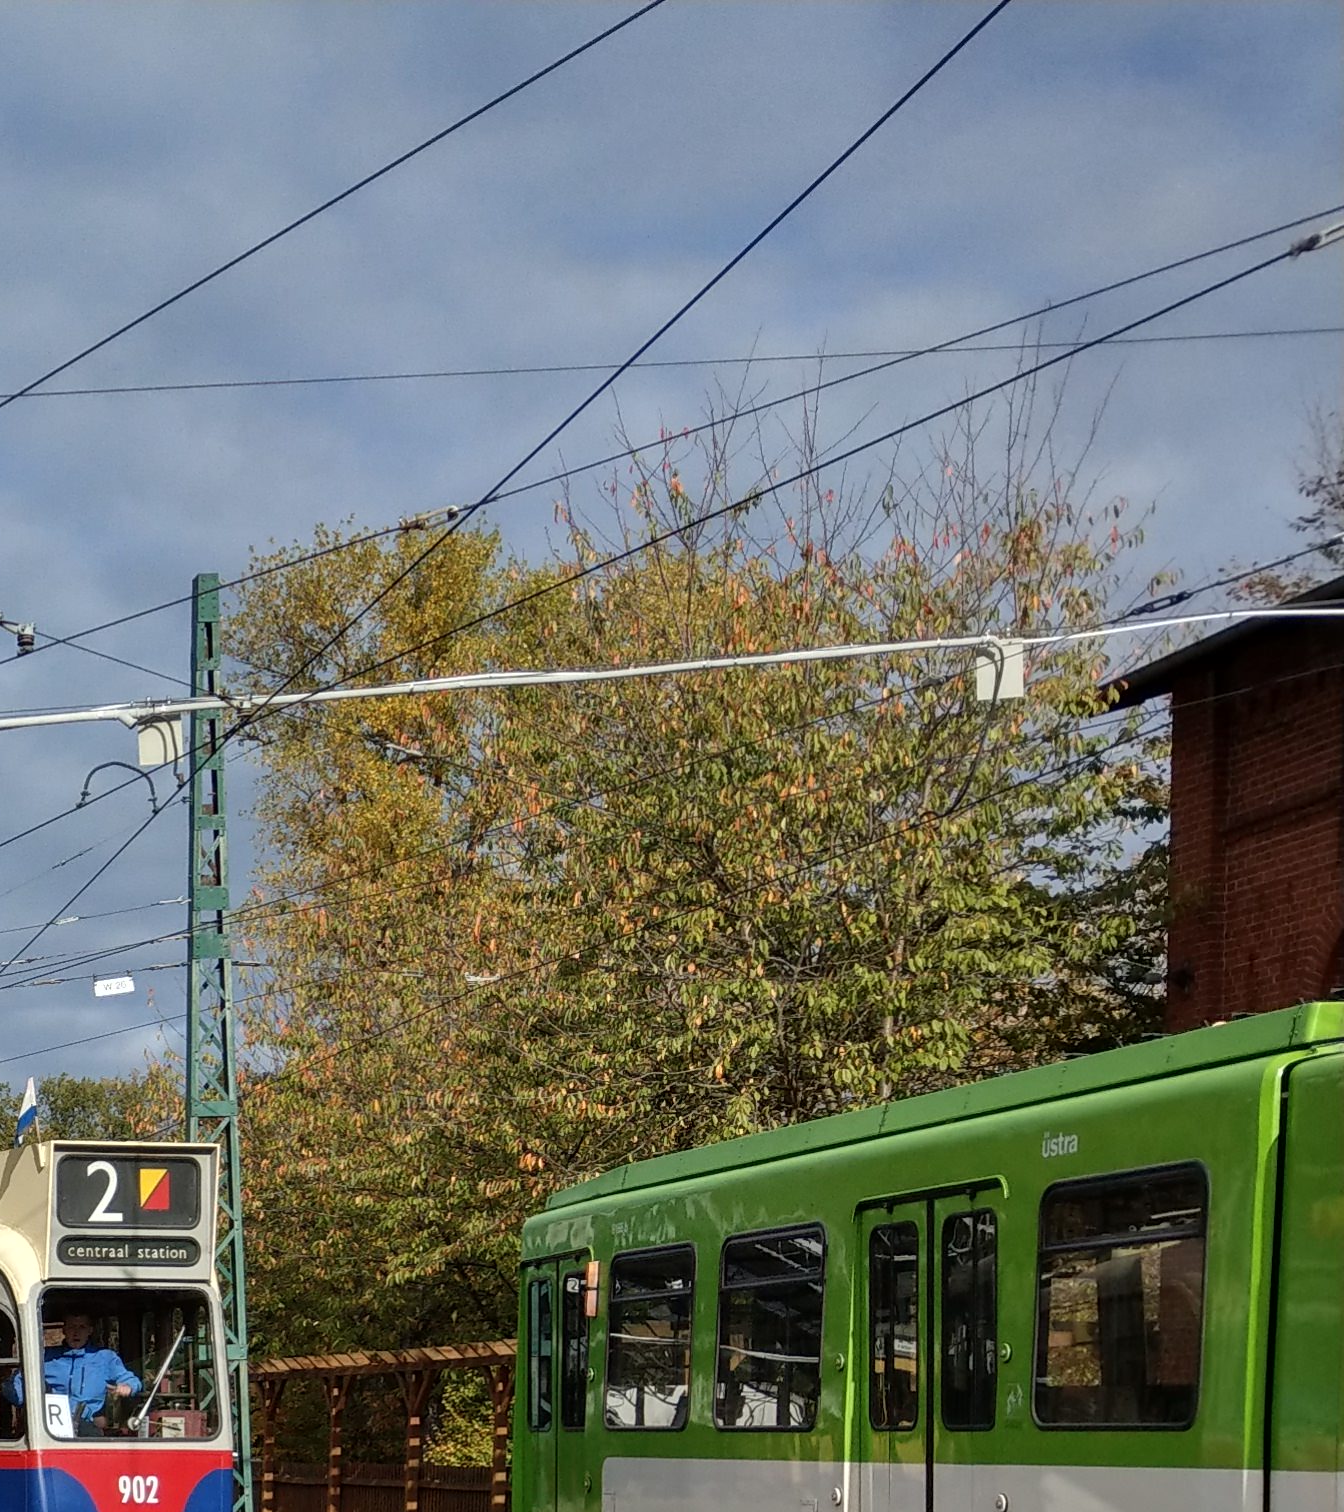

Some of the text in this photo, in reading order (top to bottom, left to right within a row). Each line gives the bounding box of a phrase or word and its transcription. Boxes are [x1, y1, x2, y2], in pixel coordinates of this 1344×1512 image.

[1042, 1132, 1078, 1158] üstra
[87, 1160, 124, 1222] 2
[67, 1244, 187, 1259] centraal station
[48, 1404, 64, 1426] R
[118, 1475, 160, 1504] 902
